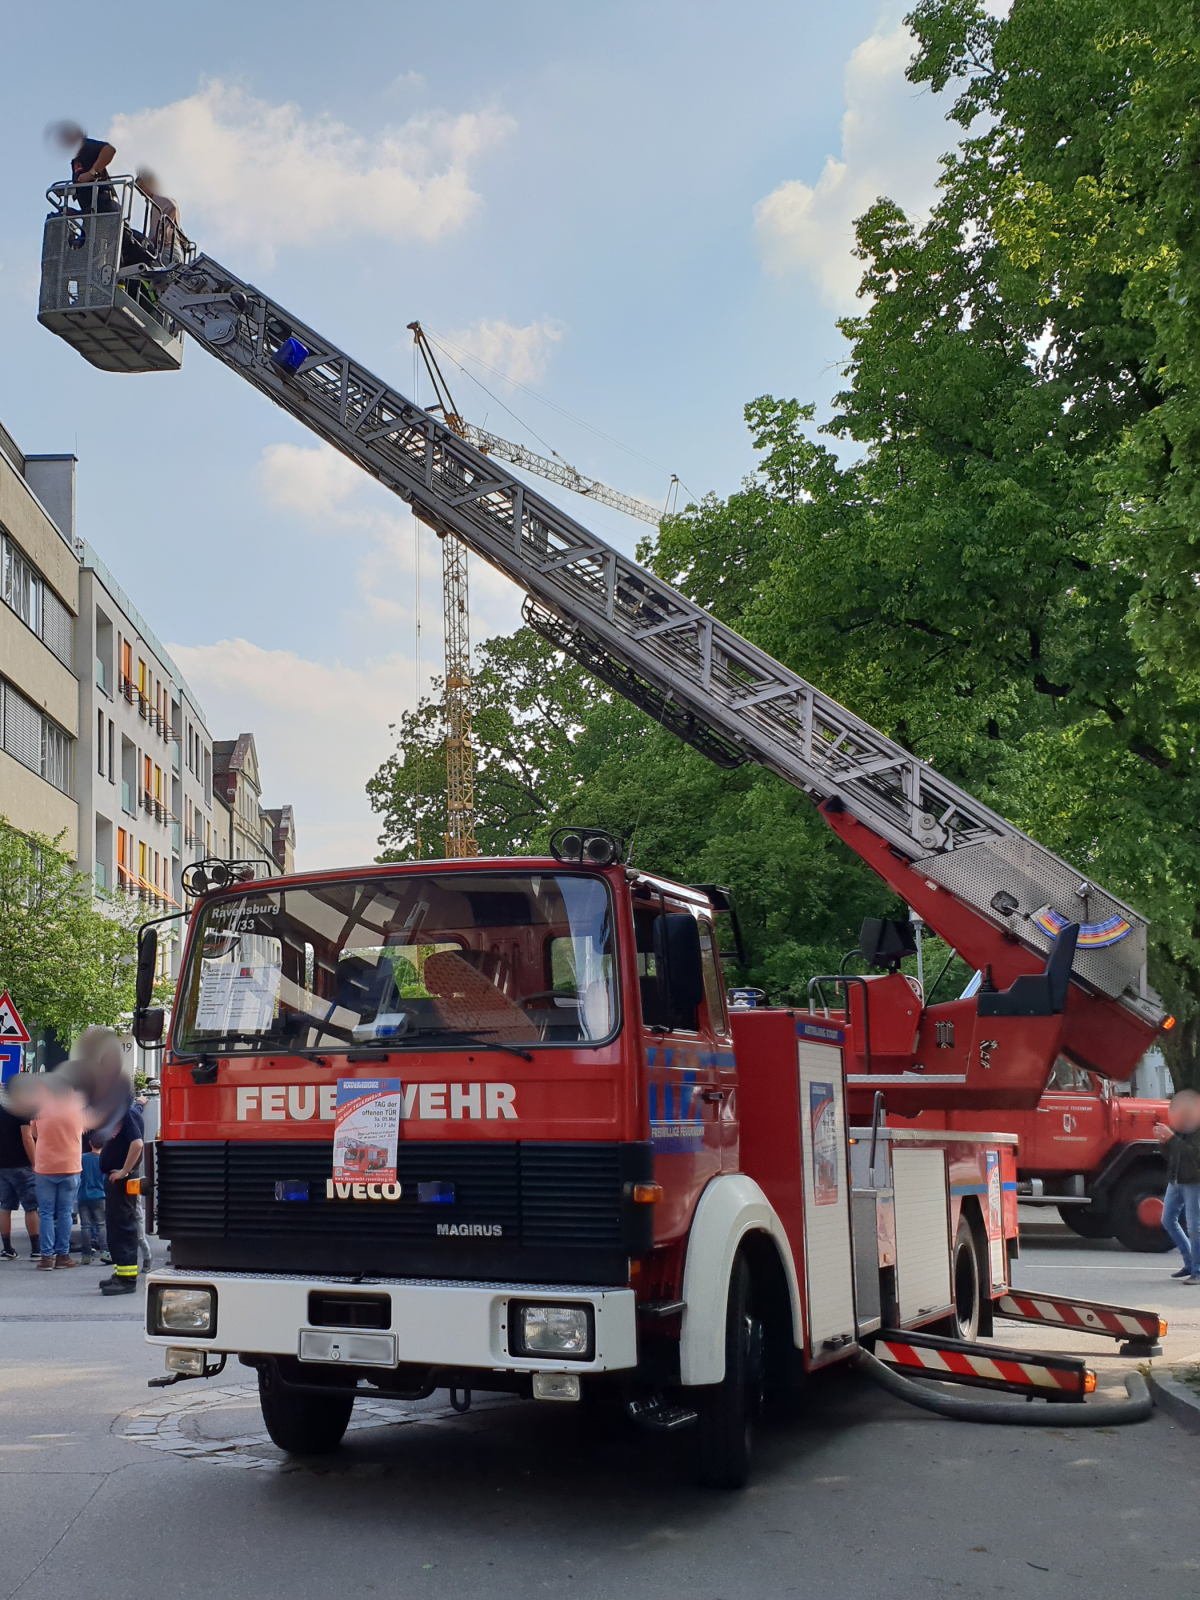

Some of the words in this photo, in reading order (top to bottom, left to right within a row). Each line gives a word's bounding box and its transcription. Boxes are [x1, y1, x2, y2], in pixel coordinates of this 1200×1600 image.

[211, 904, 281, 919] Ravensburg
[121, 1042, 133, 1053] 19
[236, 1082, 519, 1121] FEUEEHR
[385, 1107, 397, 1116] TÜR
[325, 1178, 402, 1201] IVECO
[436, 1223, 503, 1237] MAGIRUS
